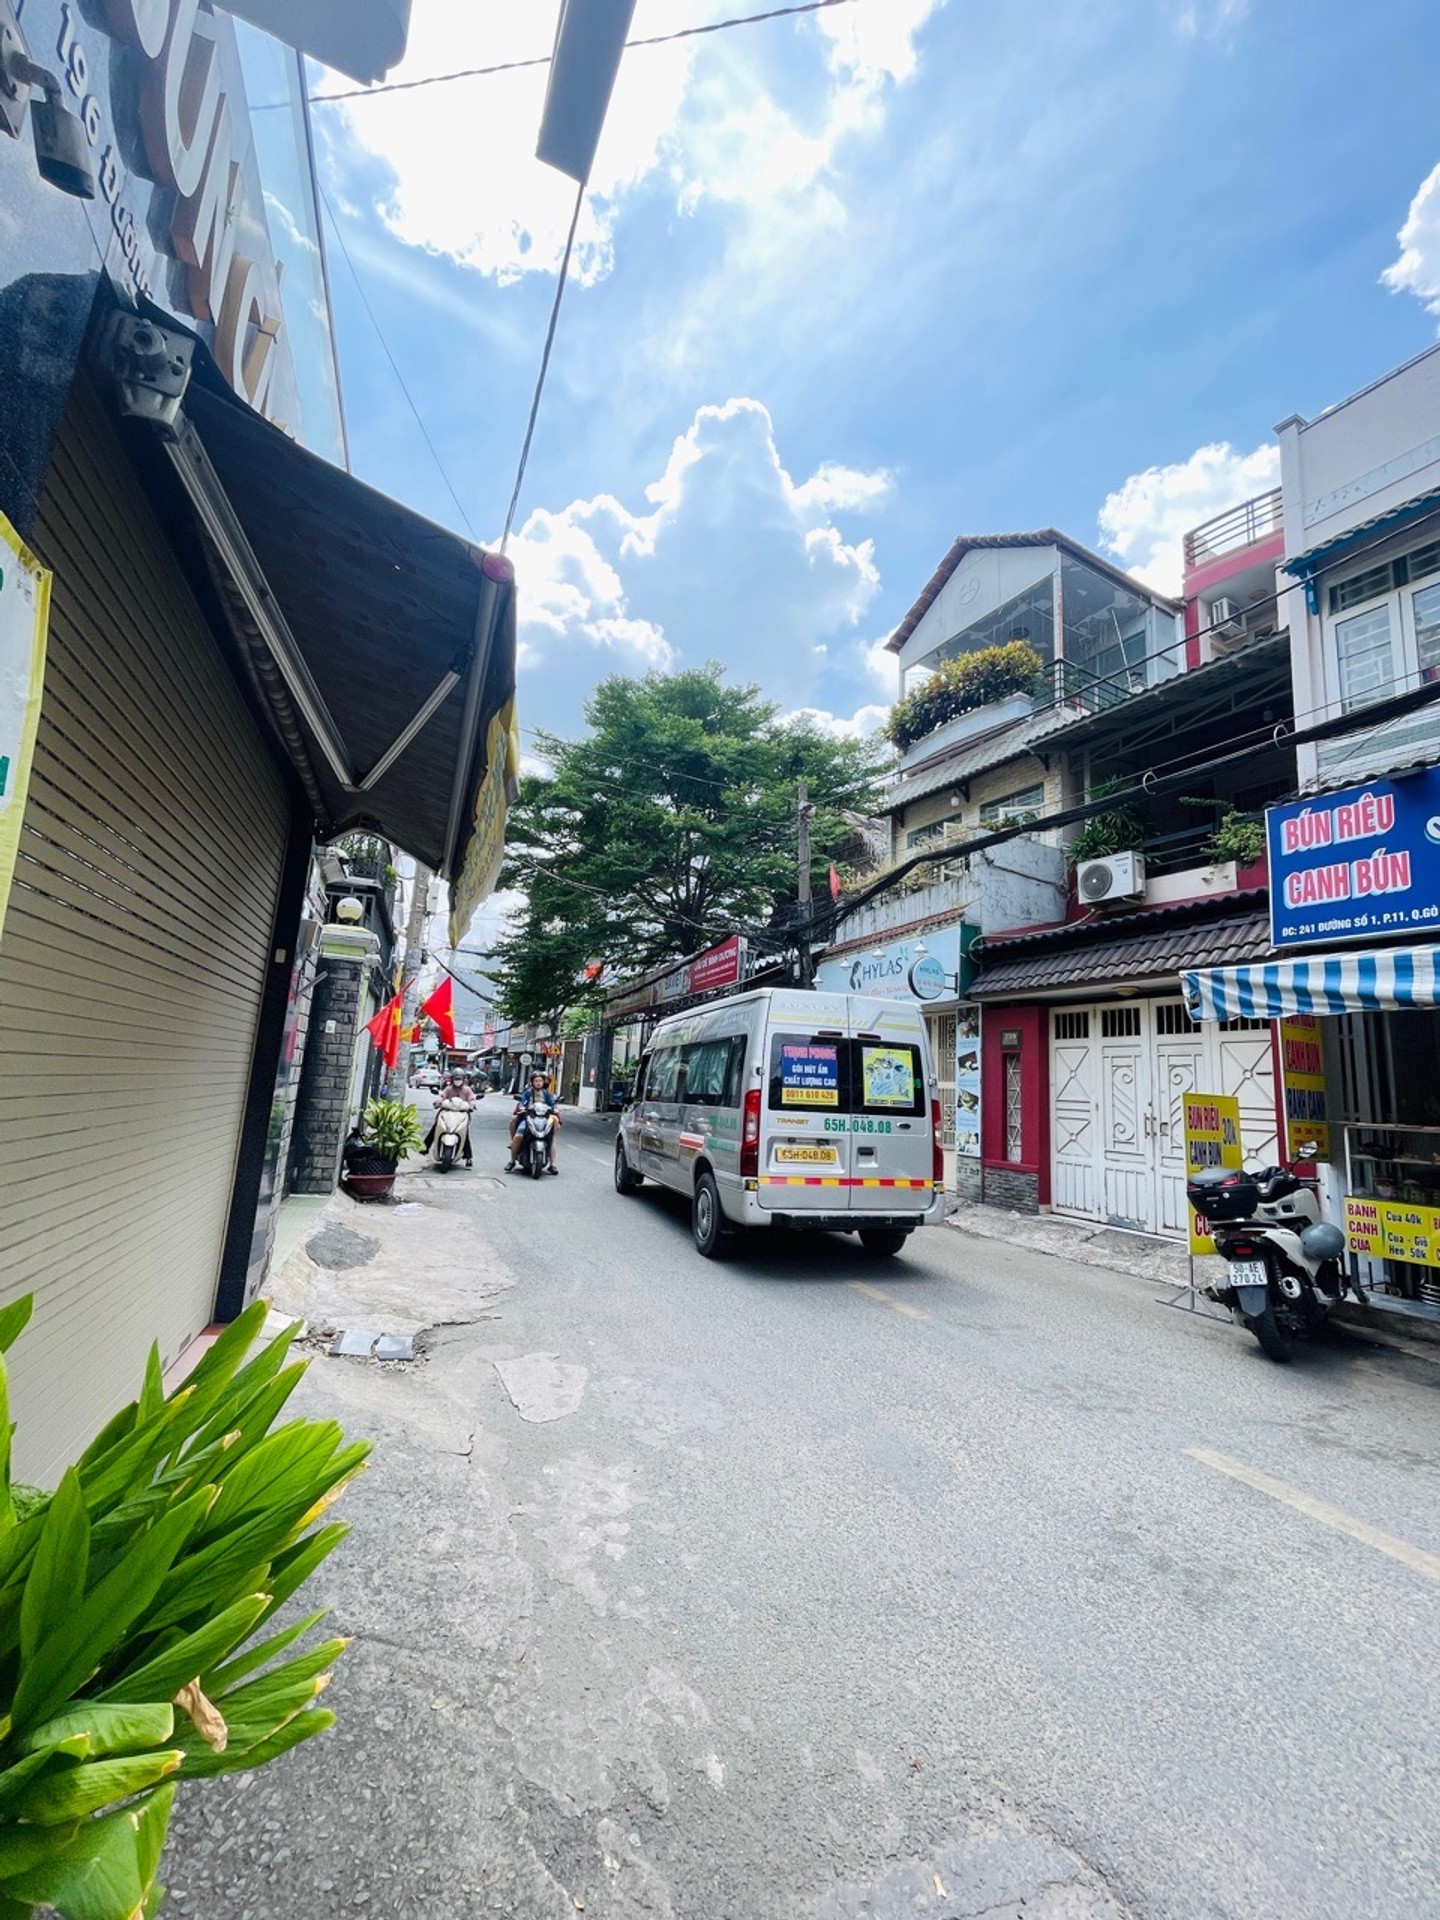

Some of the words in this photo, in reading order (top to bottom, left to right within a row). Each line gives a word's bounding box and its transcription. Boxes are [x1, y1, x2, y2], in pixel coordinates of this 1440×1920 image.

[57, 3, 101, 147] 196
[1281, 807, 1332, 855] BÚN
[1333, 792, 1395, 844] RIÊU
[1284, 862, 1350, 909] CANH
[1351, 848, 1412, 899] BÚN
[1299, 923, 1316, 936] 241
[1354, 912, 1368, 928] SỐ
[862, 956, 903, 981] HYLAS
[1348, 1220, 1379, 1236] CANH
[1387, 1231, 1404, 1243] Cua
[1349, 1237, 1371, 1252] CUA
[1388, 1244, 1405, 1256] Heo
